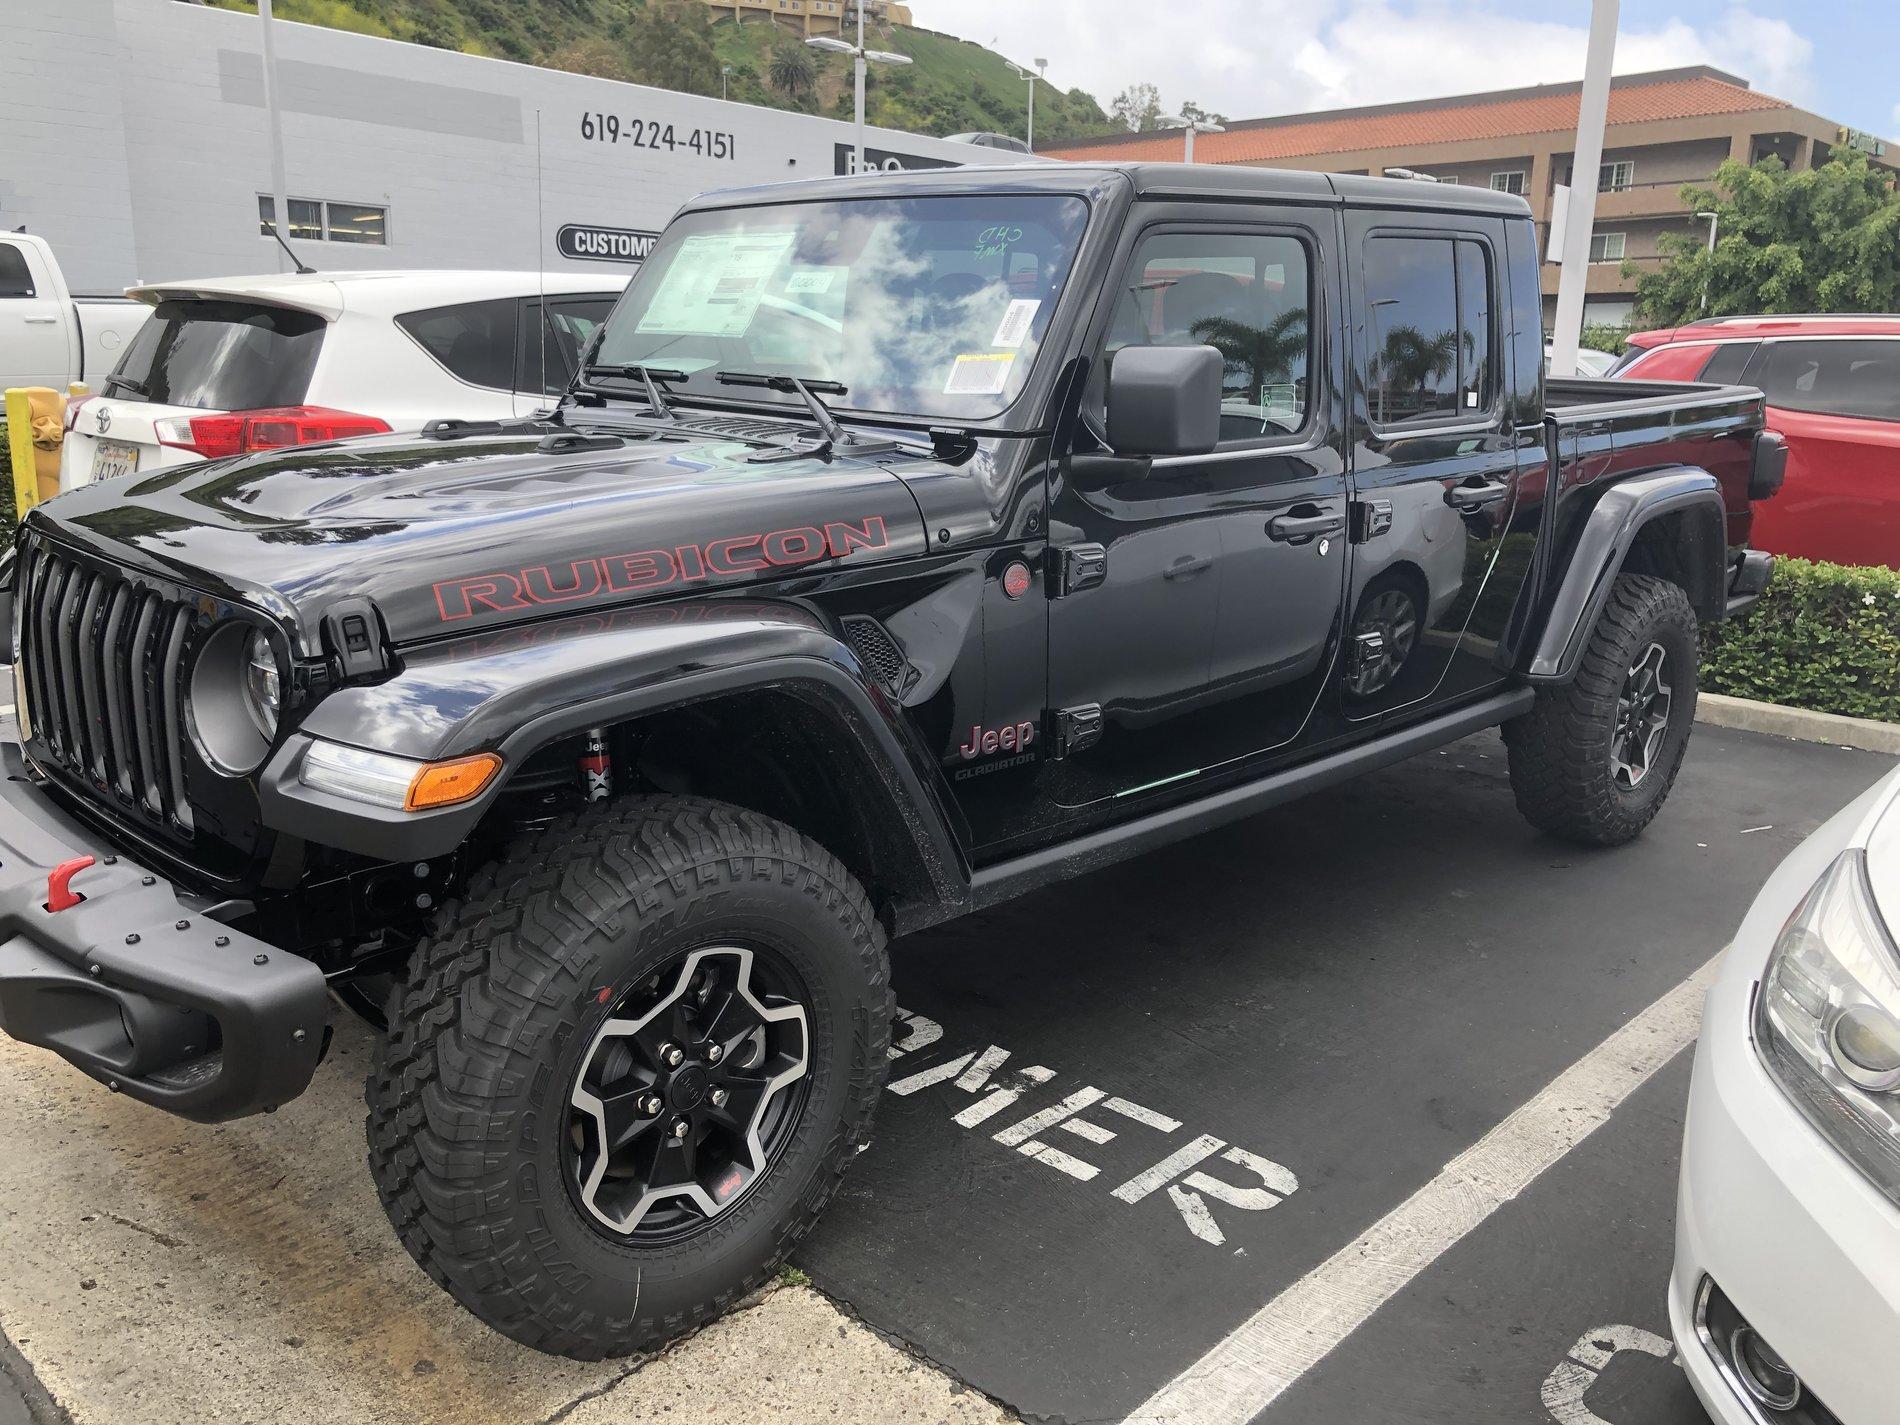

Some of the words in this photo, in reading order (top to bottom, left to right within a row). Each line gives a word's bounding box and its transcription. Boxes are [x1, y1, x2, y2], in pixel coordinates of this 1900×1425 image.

[581, 112, 736, 161] 619-224-4151
[432, 516, 888, 621] RUBICON
[585, 741, 607, 752] Jee
[960, 721, 1035, 760] Jeep
[955, 752, 1036, 780] GLADIATOR
